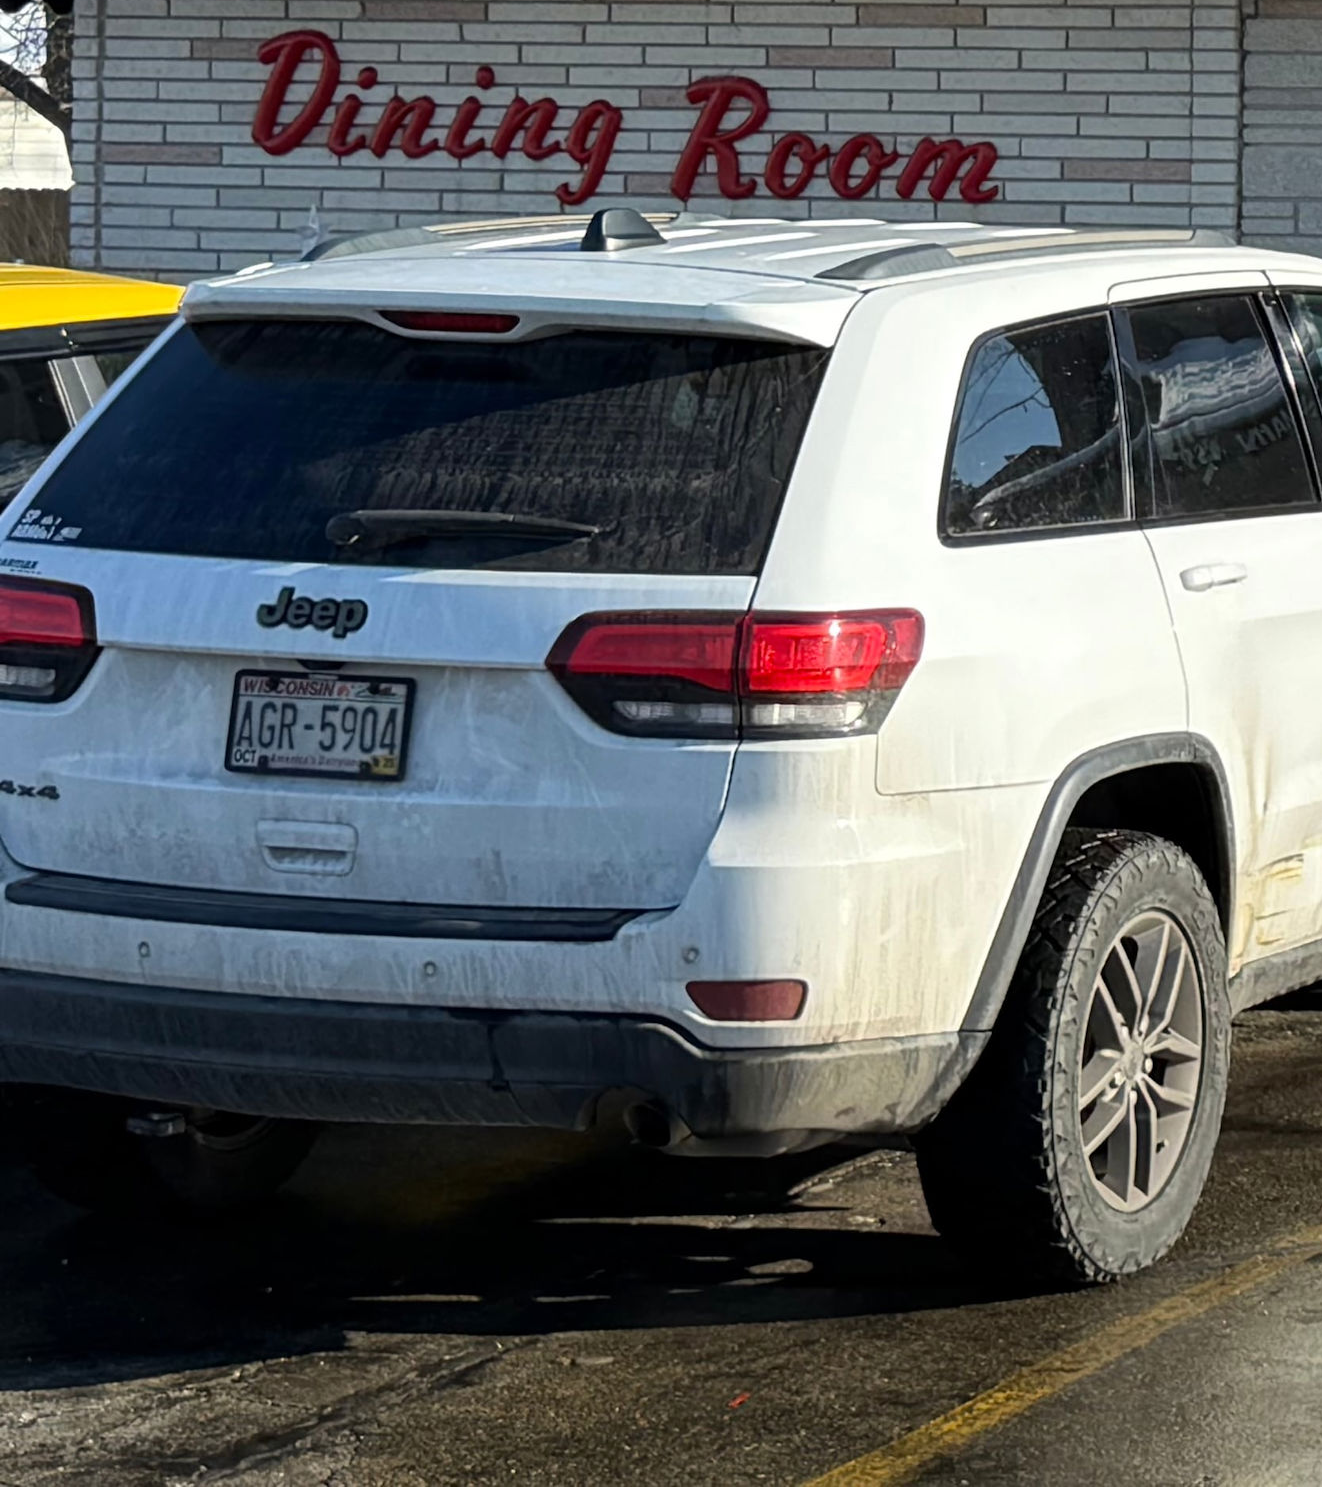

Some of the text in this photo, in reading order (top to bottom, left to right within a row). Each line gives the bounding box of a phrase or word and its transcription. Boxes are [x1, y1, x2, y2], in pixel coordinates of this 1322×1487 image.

[251, 28, 1000, 206] Dining Room
[256, 585, 369, 640] Jeep
[242, 676, 337, 699] WISCONSIN
[235, 700, 399, 756] AGR-5904
[233, 748, 258, 763] OCT
[0, 779, 61, 801] 4x4
